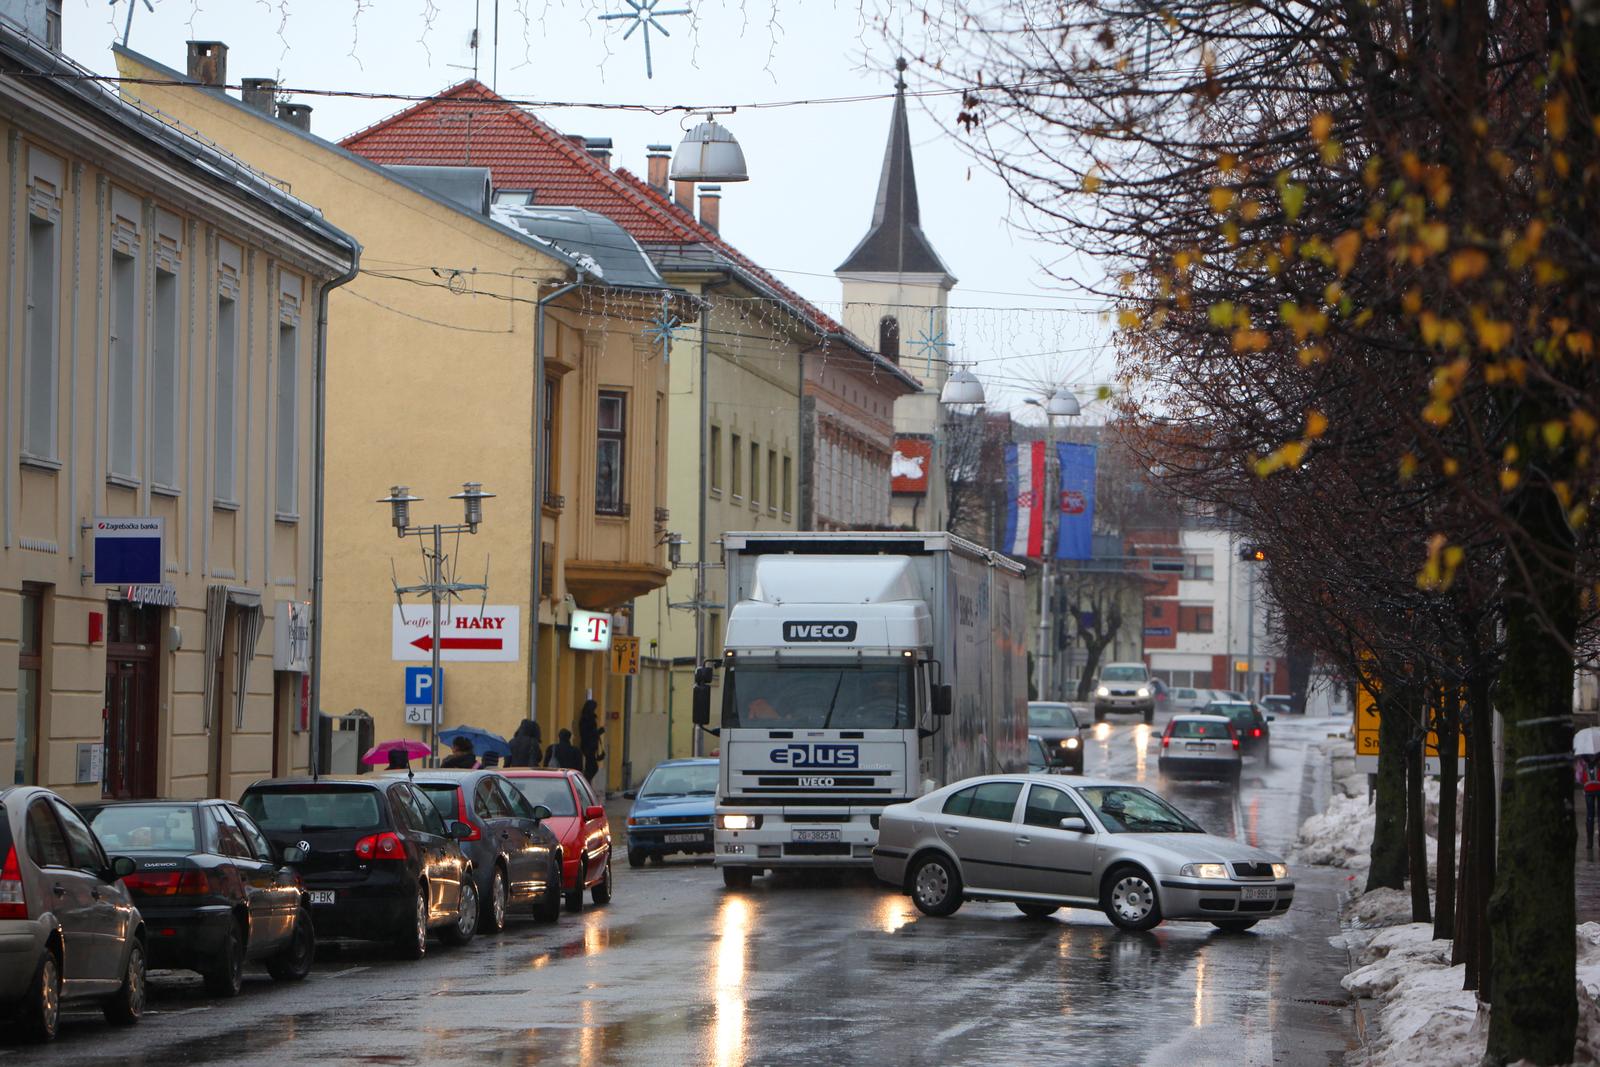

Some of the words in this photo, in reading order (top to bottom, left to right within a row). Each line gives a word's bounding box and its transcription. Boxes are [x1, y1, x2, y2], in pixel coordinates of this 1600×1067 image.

[106, 523, 139, 531] Zagrebačka
[405, 617, 431, 628] caffe
[455, 616, 505, 629] HARY
[588, 617, 609, 642] T
[789, 625, 849, 638] IVECO
[628, 640, 637, 674] PINO
[769, 744, 859, 768] eplus
[798, 777, 835, 787] IVECO
